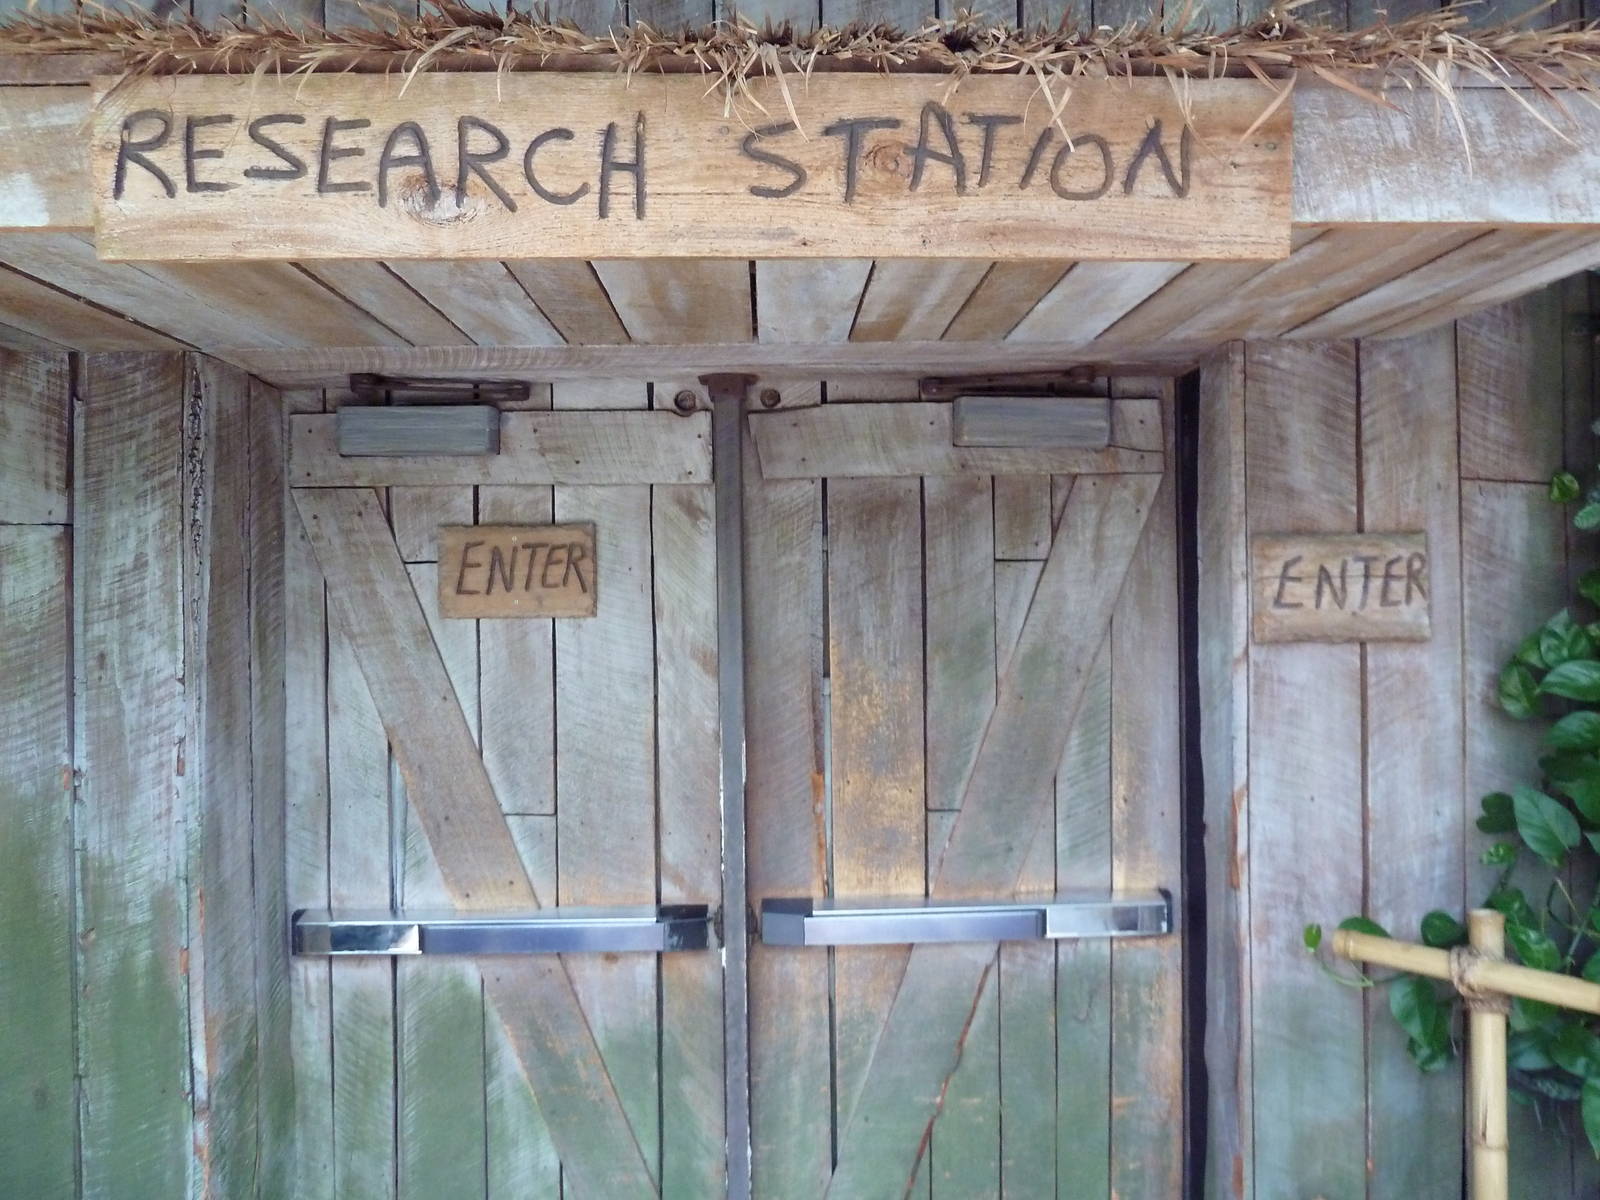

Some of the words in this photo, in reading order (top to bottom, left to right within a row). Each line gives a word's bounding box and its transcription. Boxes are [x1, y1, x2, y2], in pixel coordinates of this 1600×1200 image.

[113, 108, 646, 220] RESEARCH
[739, 101, 1190, 204] STATION
[456, 540, 587, 595] ENTER
[1273, 552, 1428, 610] ENTER
